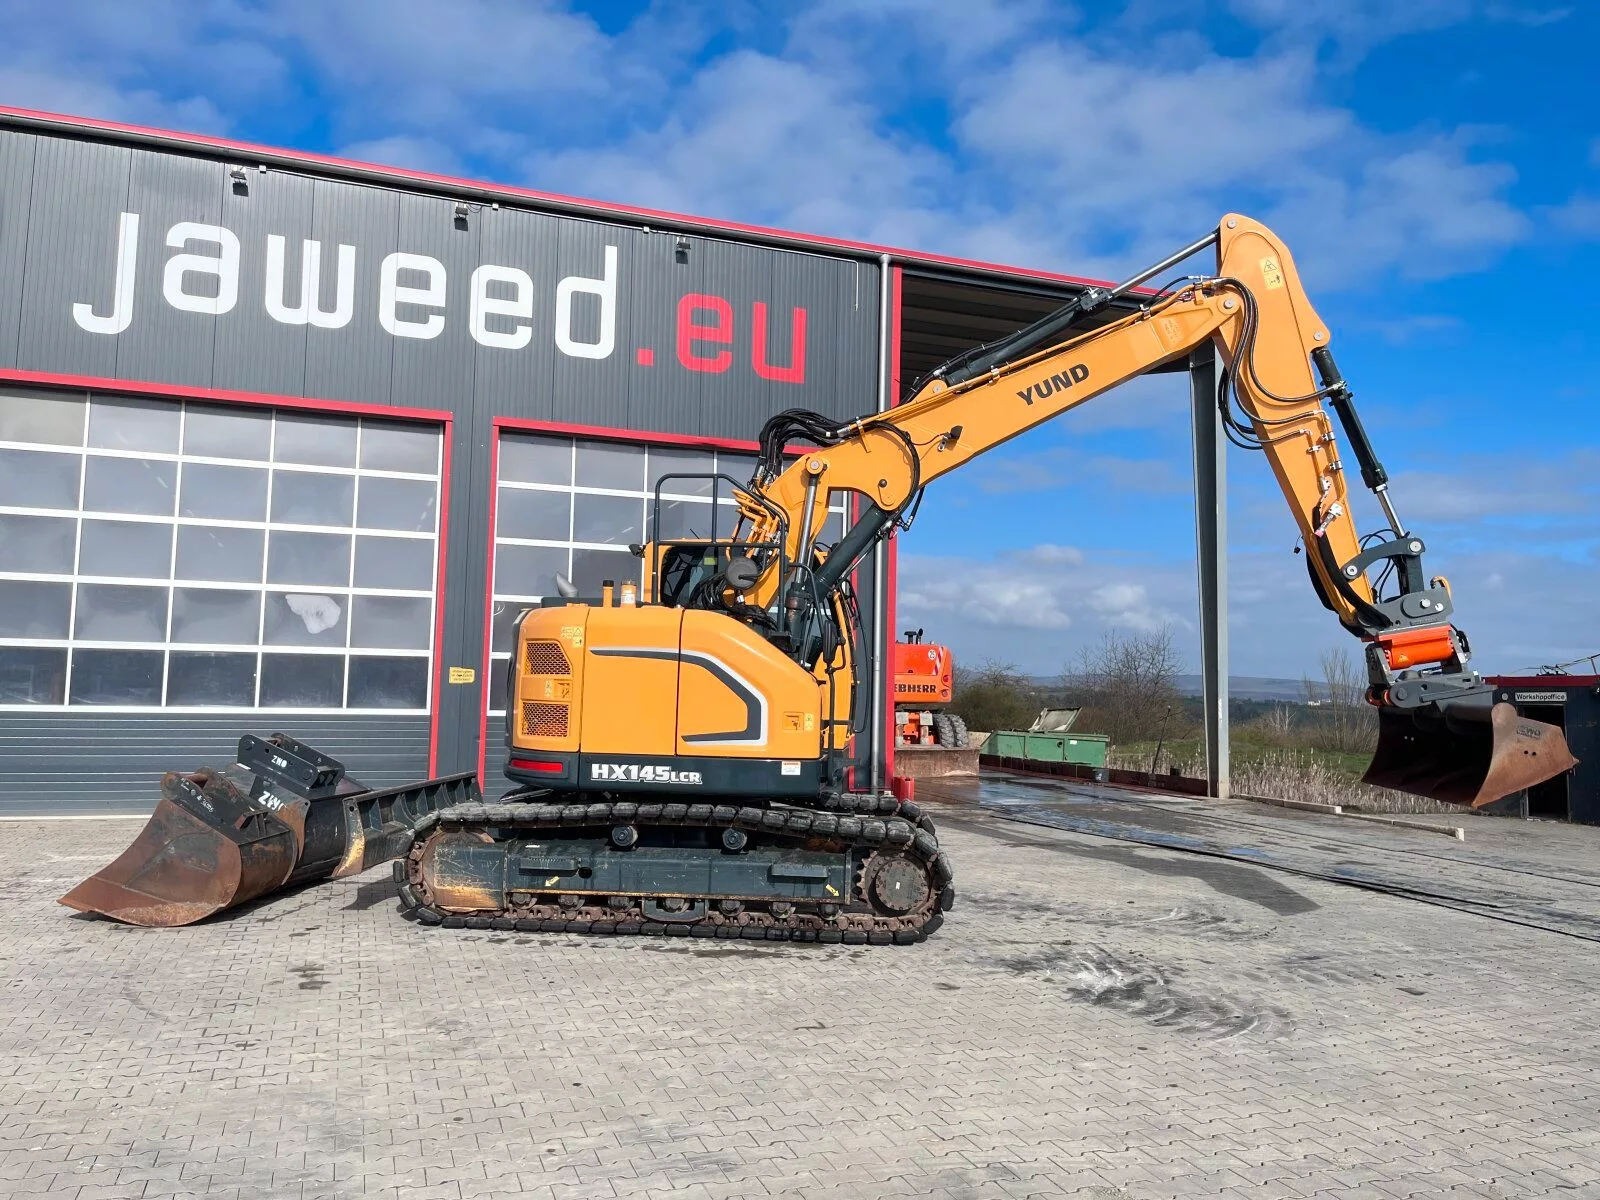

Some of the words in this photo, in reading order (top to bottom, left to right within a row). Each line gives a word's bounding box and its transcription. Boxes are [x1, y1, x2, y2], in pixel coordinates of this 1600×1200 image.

[73, 212, 806, 384] jaweed.eu
[1016, 363, 1090, 406] YUND
[1516, 693, 1565, 701] Workshopoffice
